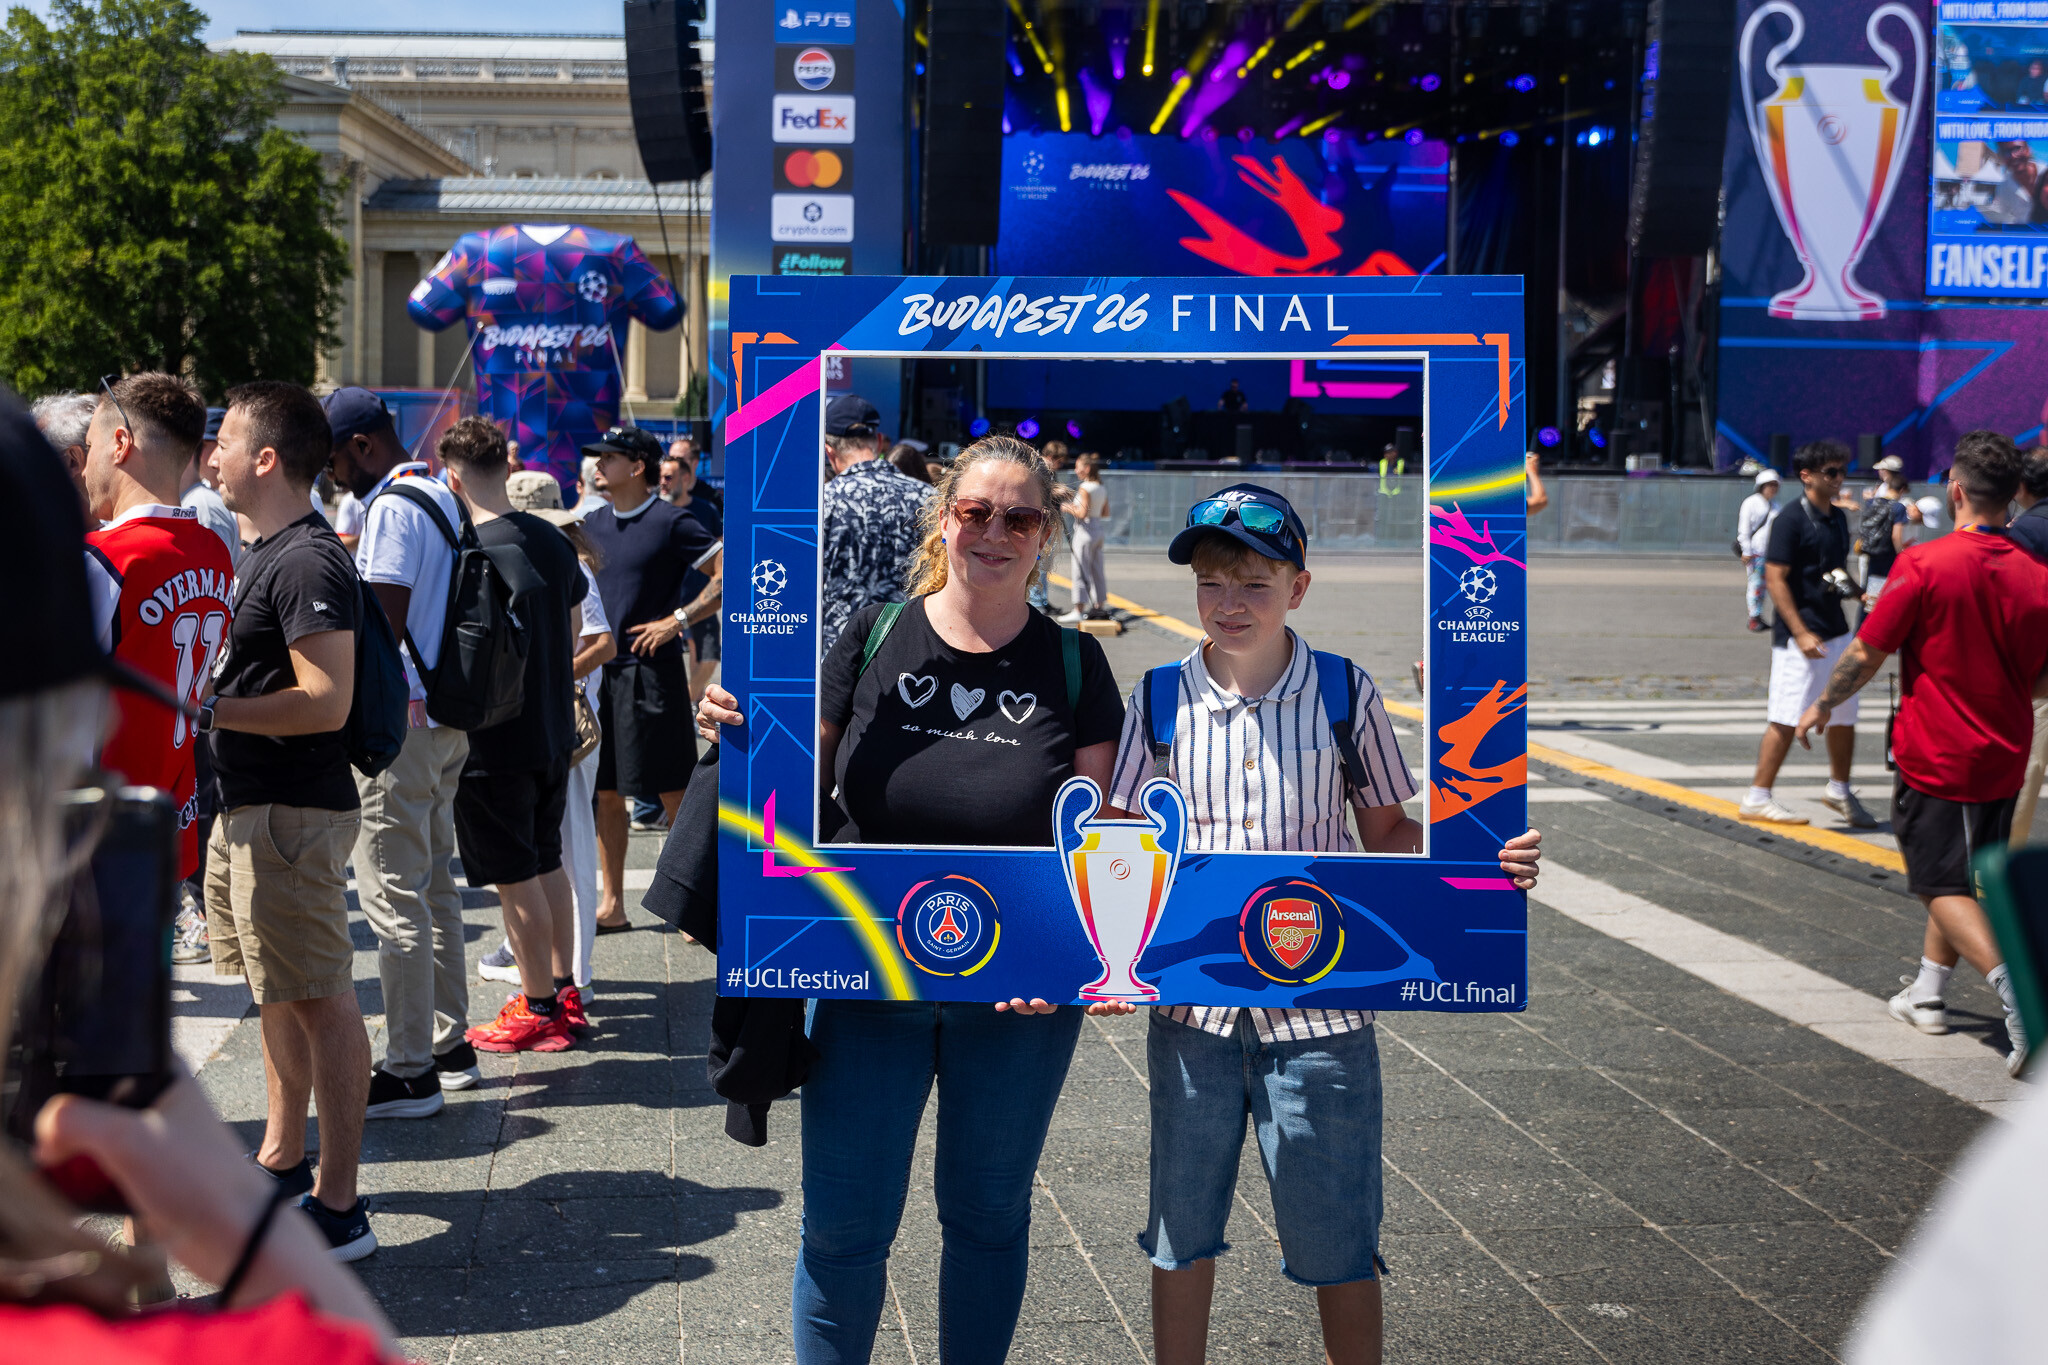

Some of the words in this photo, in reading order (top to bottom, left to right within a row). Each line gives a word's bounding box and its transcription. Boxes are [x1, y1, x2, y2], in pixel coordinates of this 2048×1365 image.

[804, 12, 851, 28] PS5
[798, 66, 832, 75] PEPSI
[781, 107, 847, 130] FedEx
[778, 225, 848, 237] crypto.com
[1930, 243, 2048, 289] FANSELF
[899, 293, 1097, 338] BUDAPEST
[1093, 293, 1150, 334] 26
[1173, 294, 1349, 332] FINAL
[482, 323, 583, 350] BUDAPEST
[579, 323, 610, 348] 26
[514, 350, 576, 364] FINAL
[138, 567, 235, 626] OVERMAR
[756, 600, 781, 611] UEFA
[1465, 608, 1491, 618] UEFA
[729, 612, 808, 624] CHAMPIONS
[743, 624, 794, 635] LEAGUE
[1437, 620, 1520, 632] CHAMPIONS
[1452, 632, 1506, 643] LEAGUE
[901, 724, 921, 732] so
[926, 728, 978, 740] much
[983, 731, 1021, 746] love
[926, 895, 970, 912] PARIS
[1269, 909, 1314, 921] Arsenal
[726, 967, 869, 990] #UCLfestival
[1400, 981, 1516, 1004] #UCLfinal
